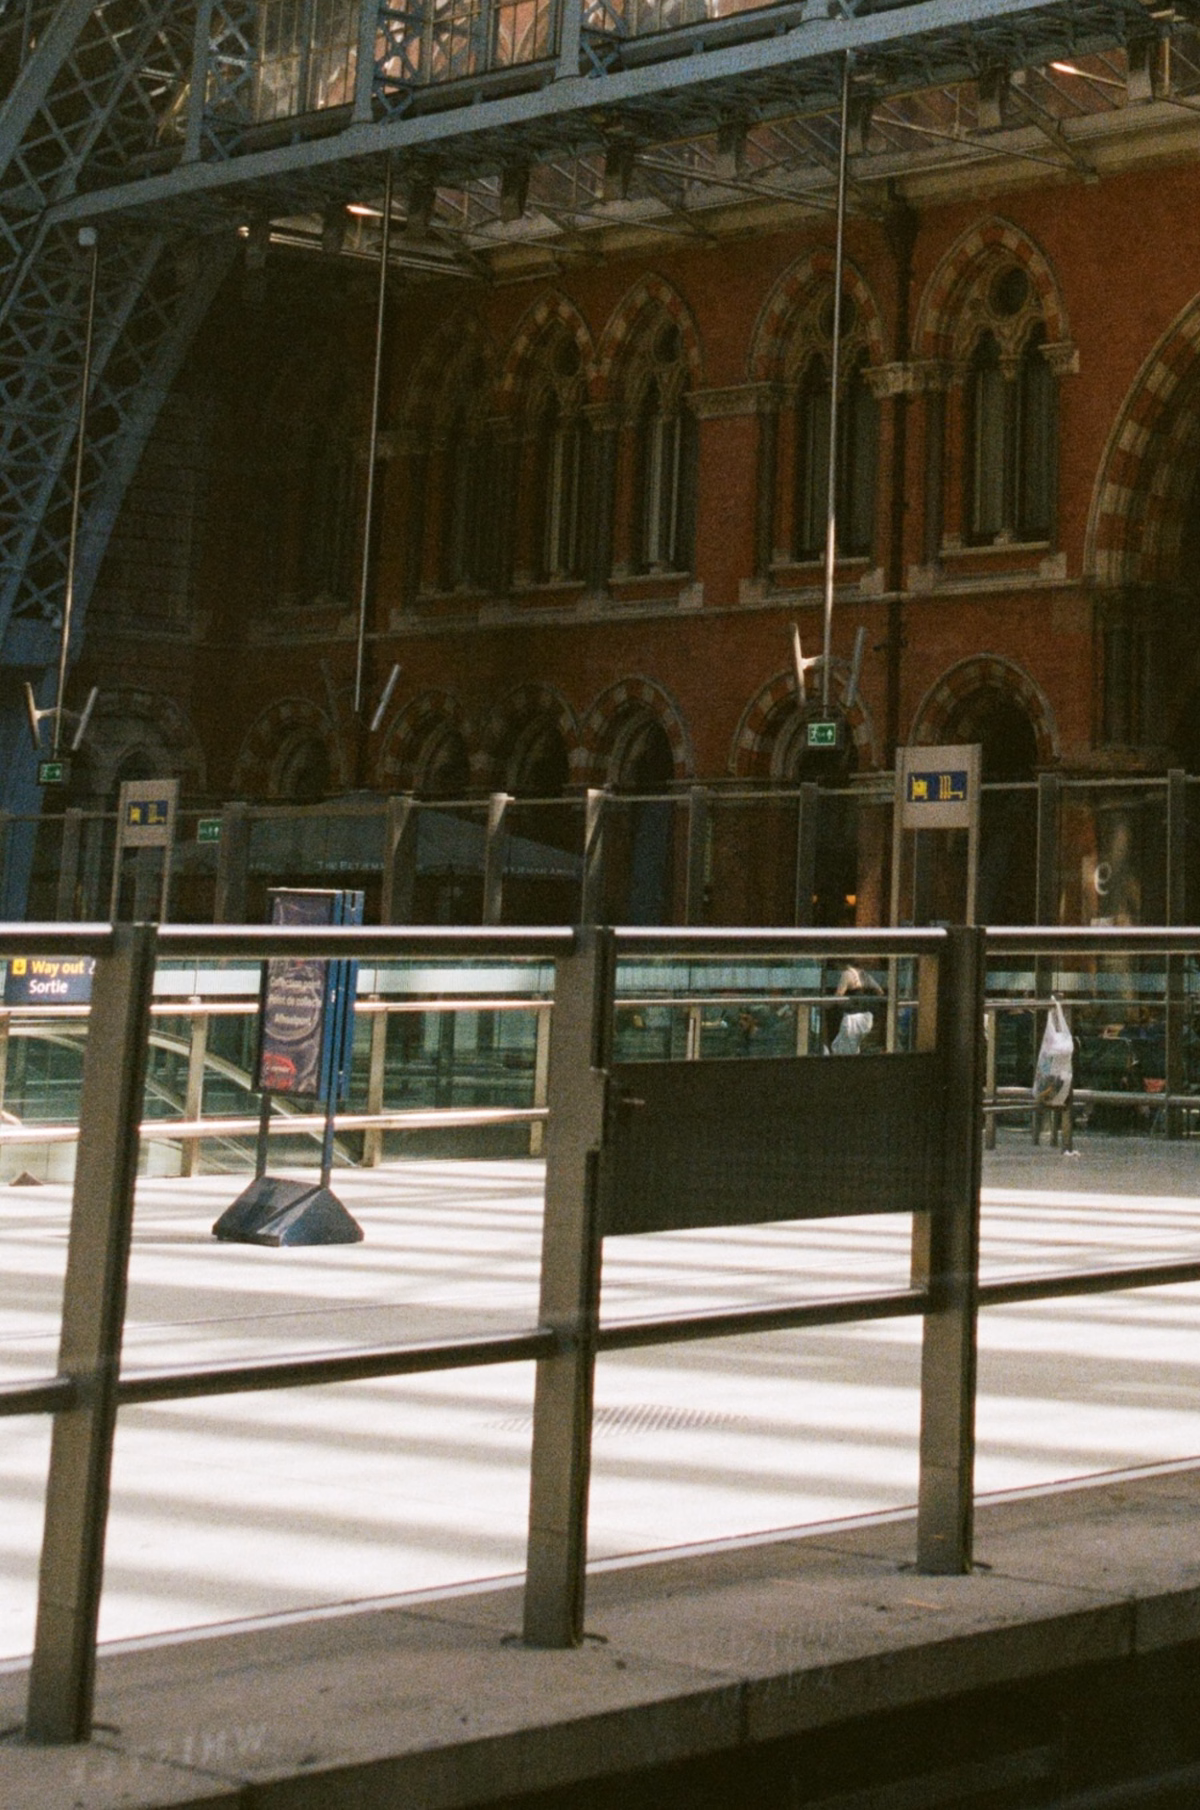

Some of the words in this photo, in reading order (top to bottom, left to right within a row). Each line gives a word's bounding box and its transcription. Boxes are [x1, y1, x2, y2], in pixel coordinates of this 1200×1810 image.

[31, 960, 60, 978] Way
[61, 960, 85, 975] out
[29, 979, 69, 995] Sortie
